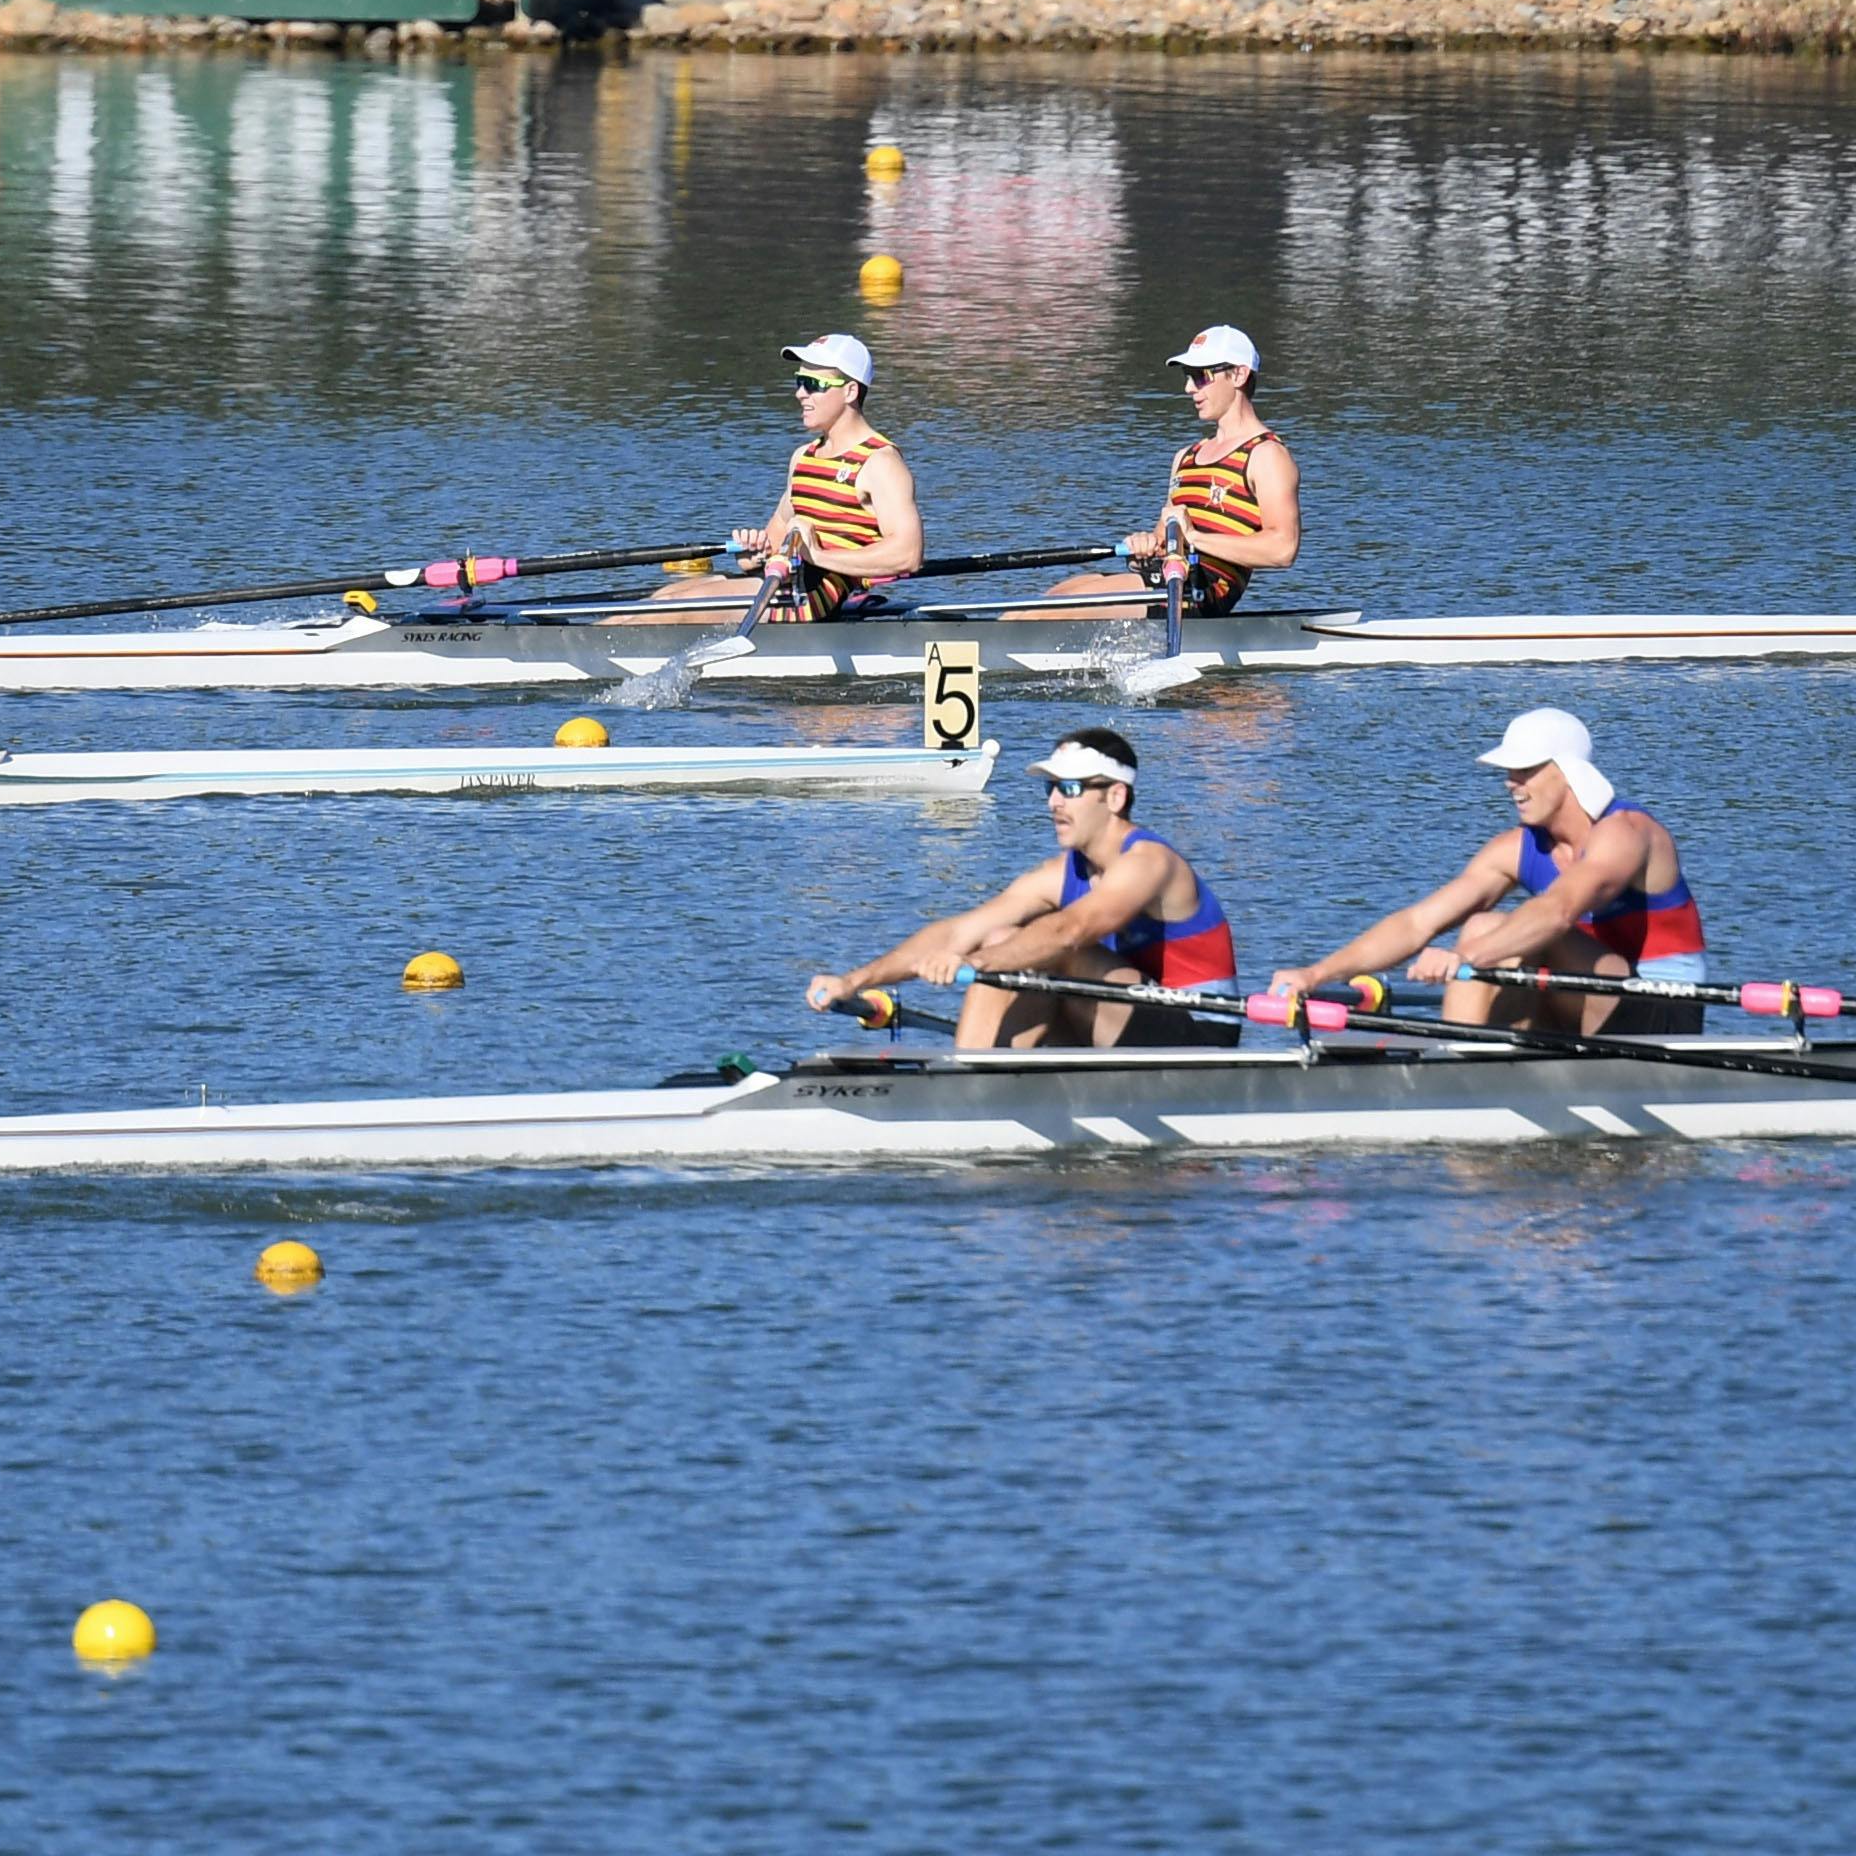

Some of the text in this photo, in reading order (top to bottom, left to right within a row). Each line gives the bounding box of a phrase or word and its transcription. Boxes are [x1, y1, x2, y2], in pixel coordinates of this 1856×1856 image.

[438, 631, 483, 643] RACING
[927, 642, 943, 667] A
[932, 665, 976, 740] 5
[792, 1082, 895, 1098] SYKES
